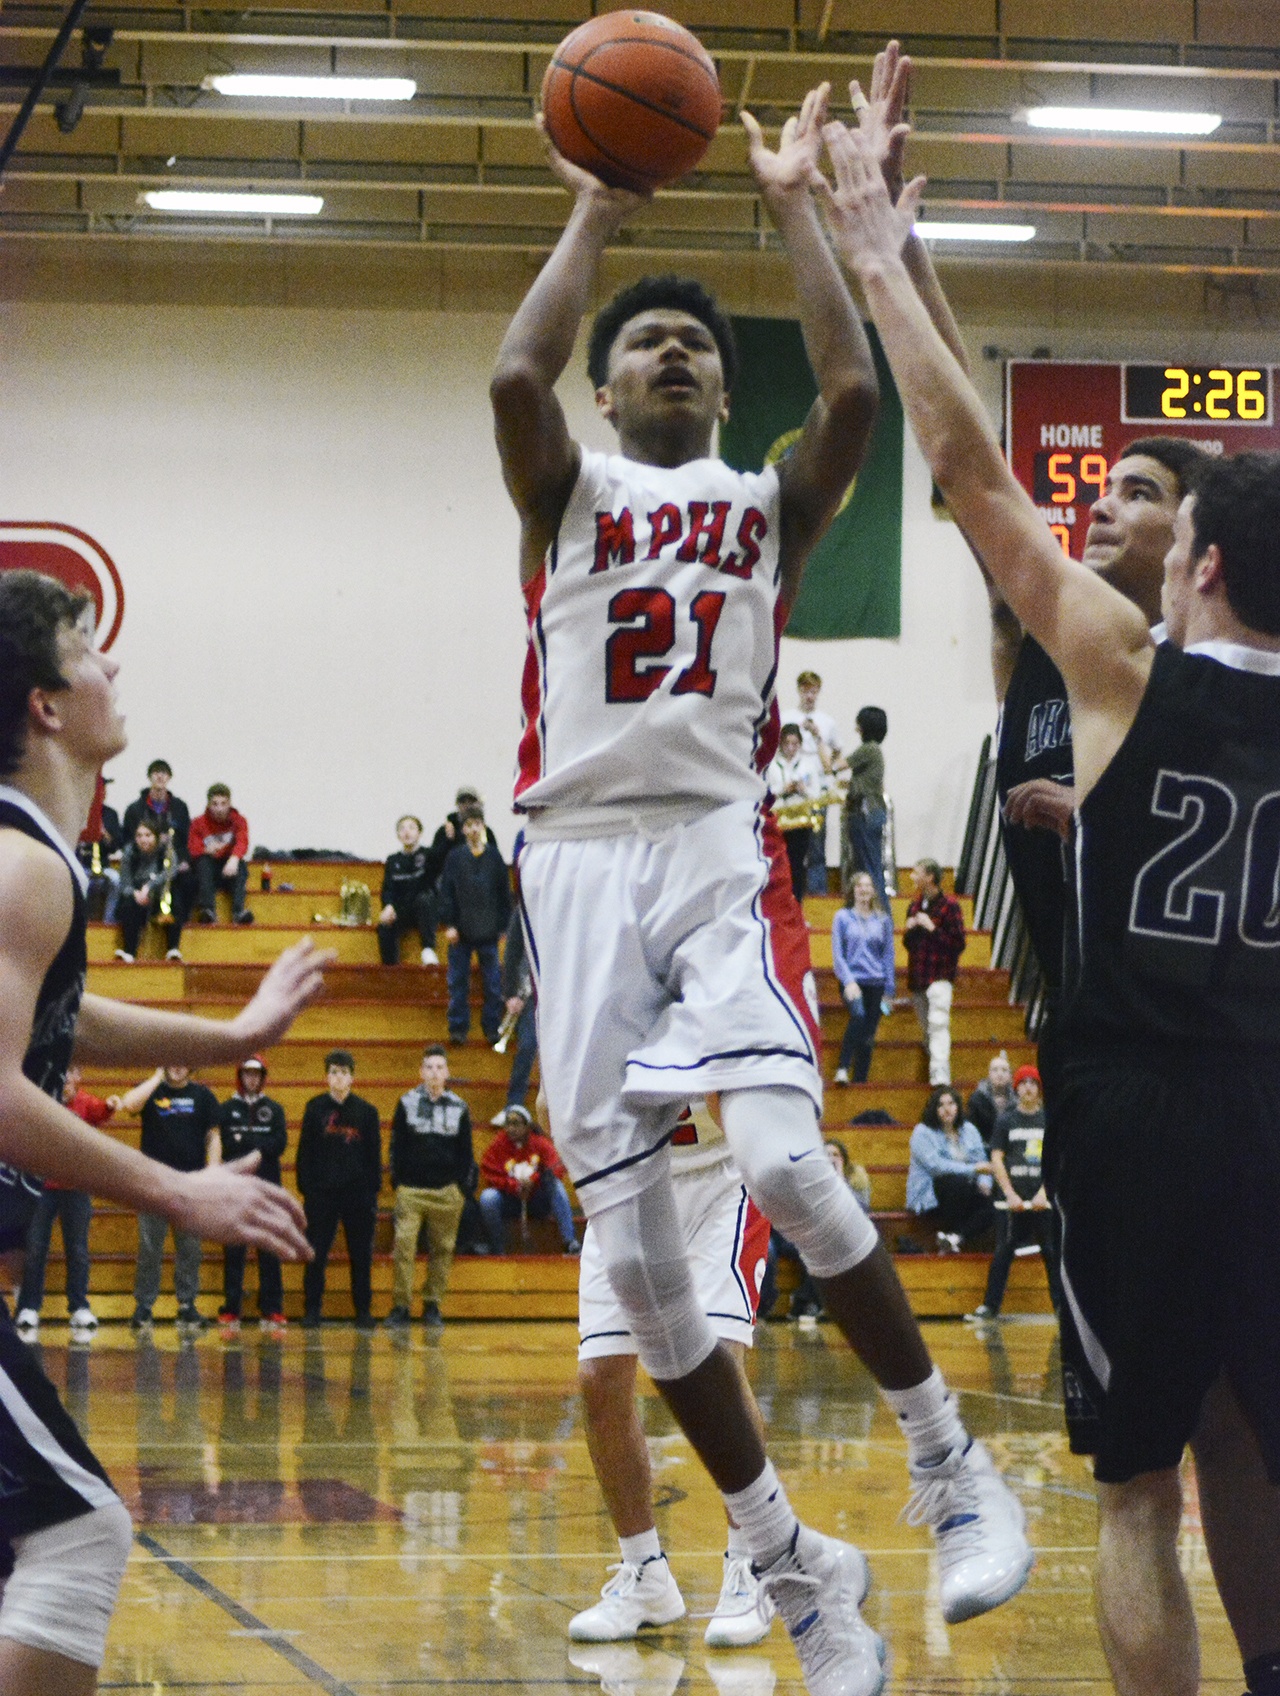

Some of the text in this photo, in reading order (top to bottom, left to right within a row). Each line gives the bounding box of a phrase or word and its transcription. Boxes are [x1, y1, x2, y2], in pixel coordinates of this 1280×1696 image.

[1161, 368, 1265, 420] 2:26
[1040, 424, 1103, 449] HOME
[1048, 453, 1107, 503] 59
[589, 501, 767, 580] MPHS
[605, 586, 727, 704] 21
